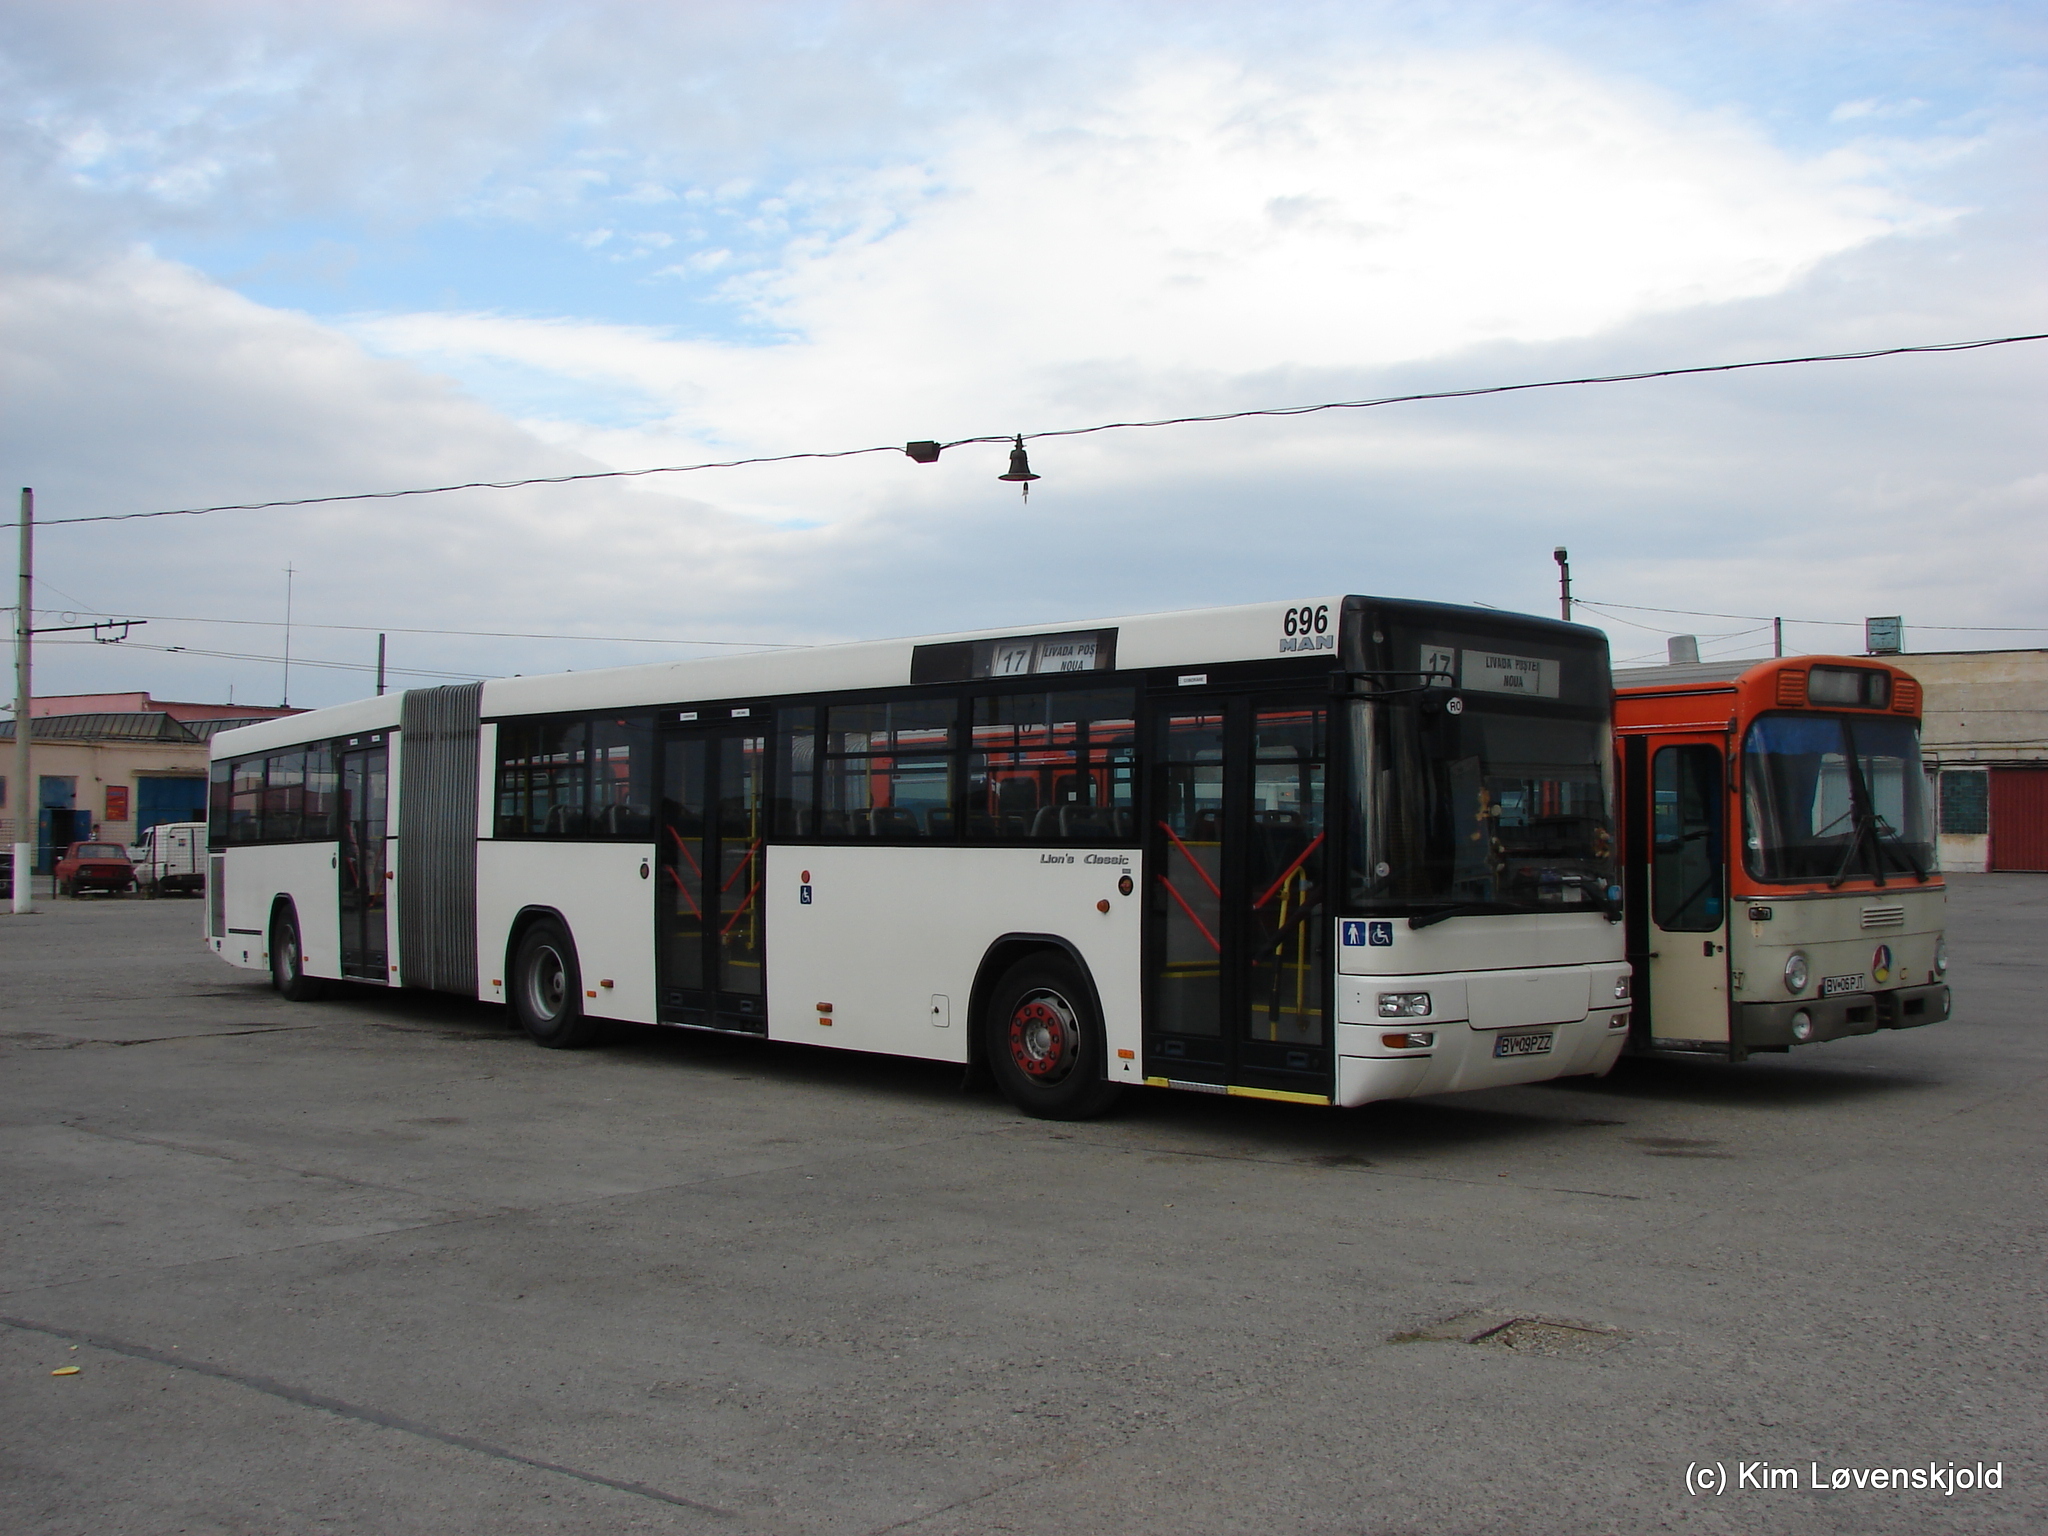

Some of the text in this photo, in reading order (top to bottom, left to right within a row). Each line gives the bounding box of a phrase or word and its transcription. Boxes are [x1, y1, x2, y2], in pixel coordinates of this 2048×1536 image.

[1284, 605, 1329, 636] 696
[1279, 635, 1334, 652] MAN
[1044, 646, 1073, 657] LIVADA
[1004, 650, 1026, 673] 17
[1060, 660, 1083, 671] NOUA
[1429, 653, 1451, 681] 17
[1486, 656, 1512, 670] LIVADA
[1503, 675, 1524, 688] NOUA
[1450, 701, 1461, 711] RO
[1040, 853, 1129, 865] Lion's Classic
